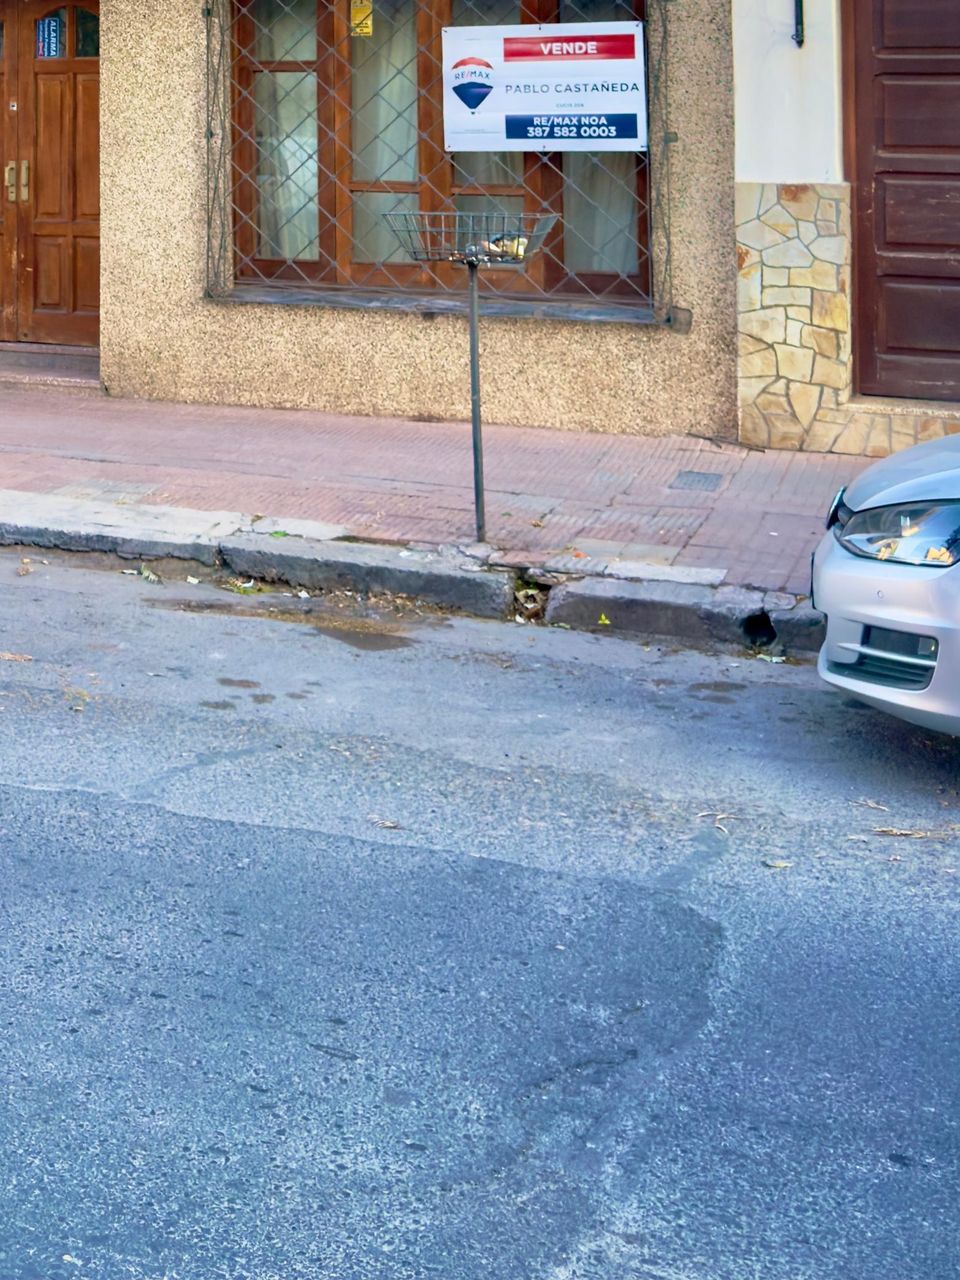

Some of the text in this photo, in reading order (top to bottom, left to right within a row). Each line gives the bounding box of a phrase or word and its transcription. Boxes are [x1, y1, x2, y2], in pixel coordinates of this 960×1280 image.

[540, 41, 598, 55] VENDE
[454, 70, 490, 80] RE/MAX
[505, 80, 640, 94] PABLO CASTAÑEDA
[533, 116, 608, 126] RE/MAX NOA
[527, 127, 617, 137] 387 582 0003
